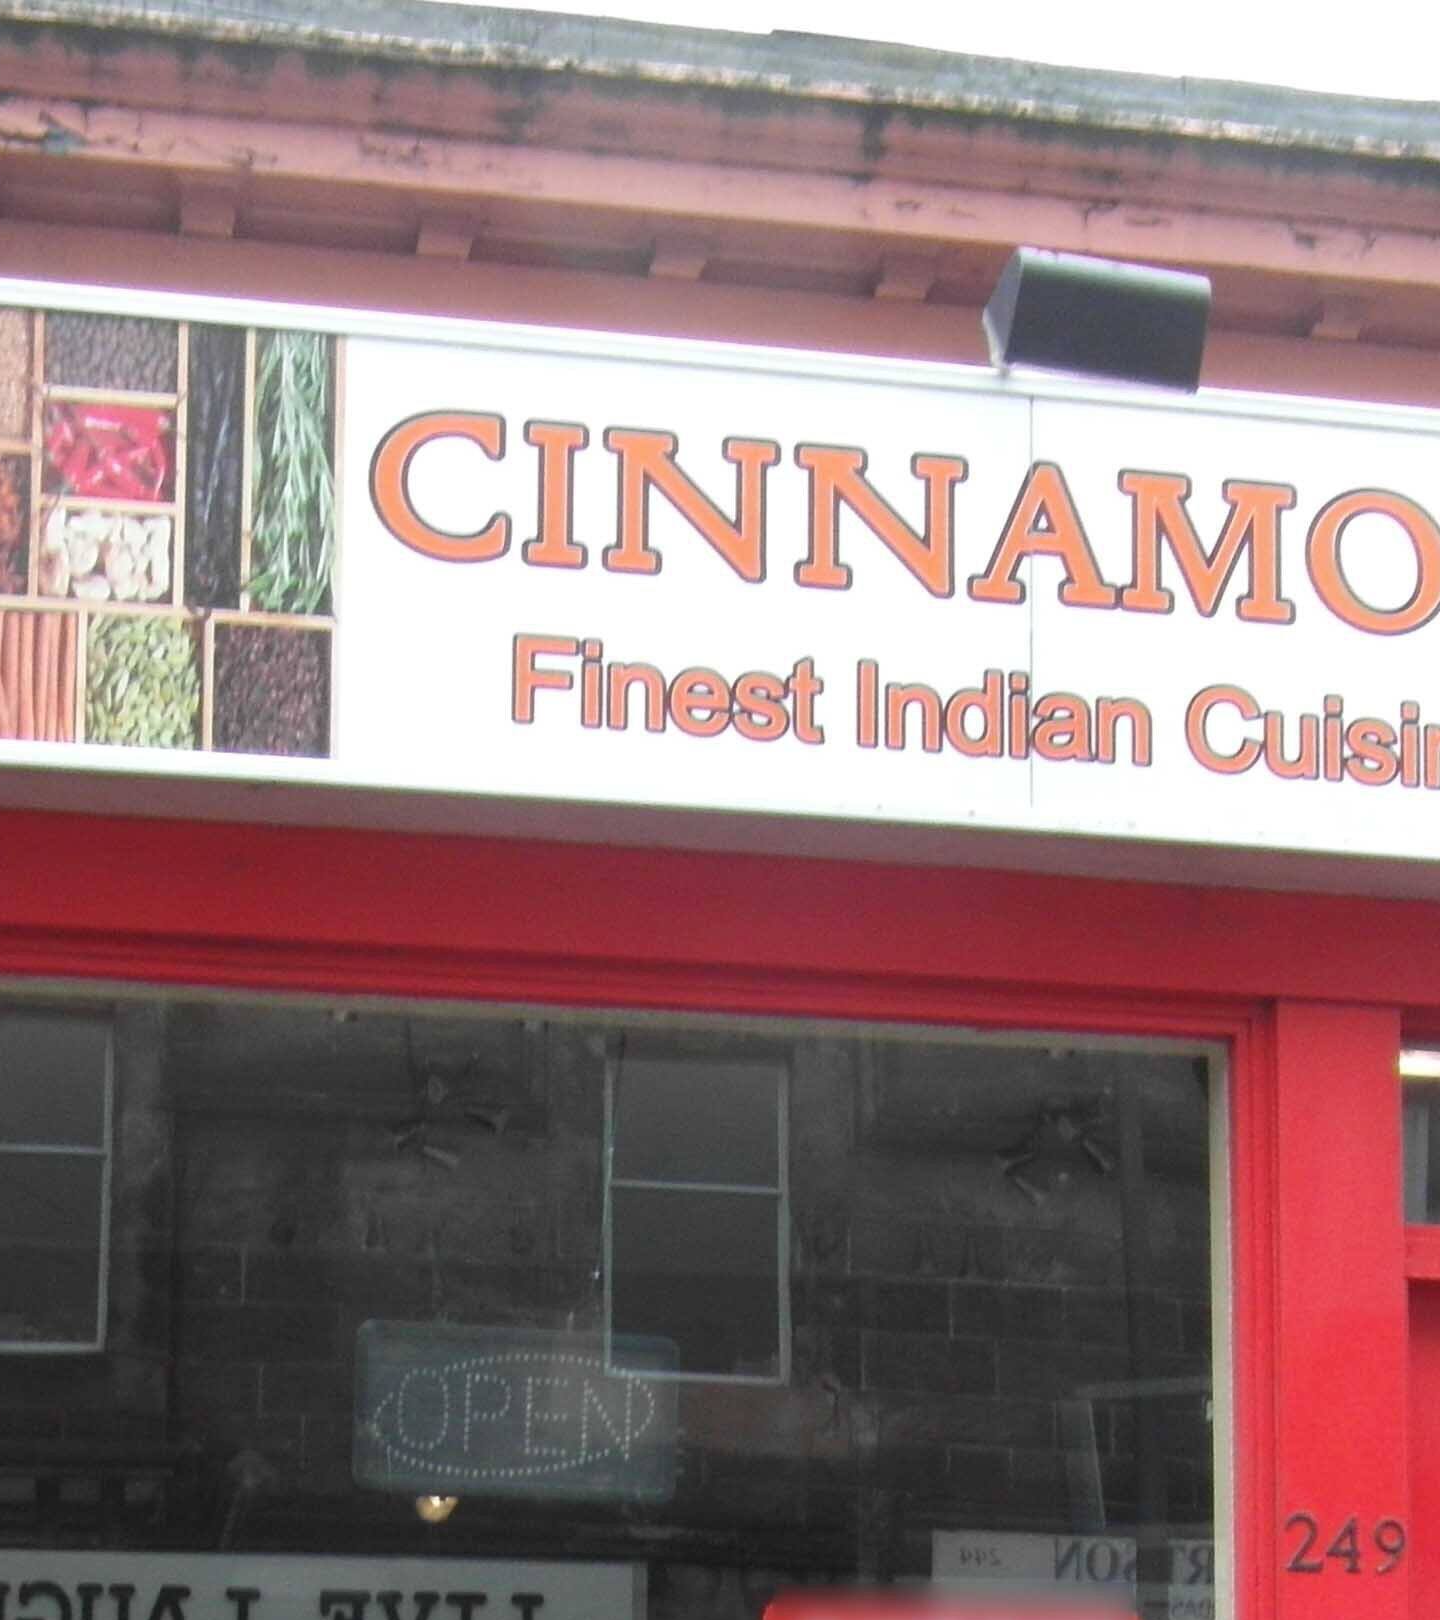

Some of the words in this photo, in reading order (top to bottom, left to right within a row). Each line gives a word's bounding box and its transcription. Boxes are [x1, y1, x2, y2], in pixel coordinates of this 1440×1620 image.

[510, 632, 824, 746] Finest
[856, 658, 1154, 769] Indian
[392, 1365, 634, 1461] OPEN
[1283, 1511, 1408, 1577] 249
